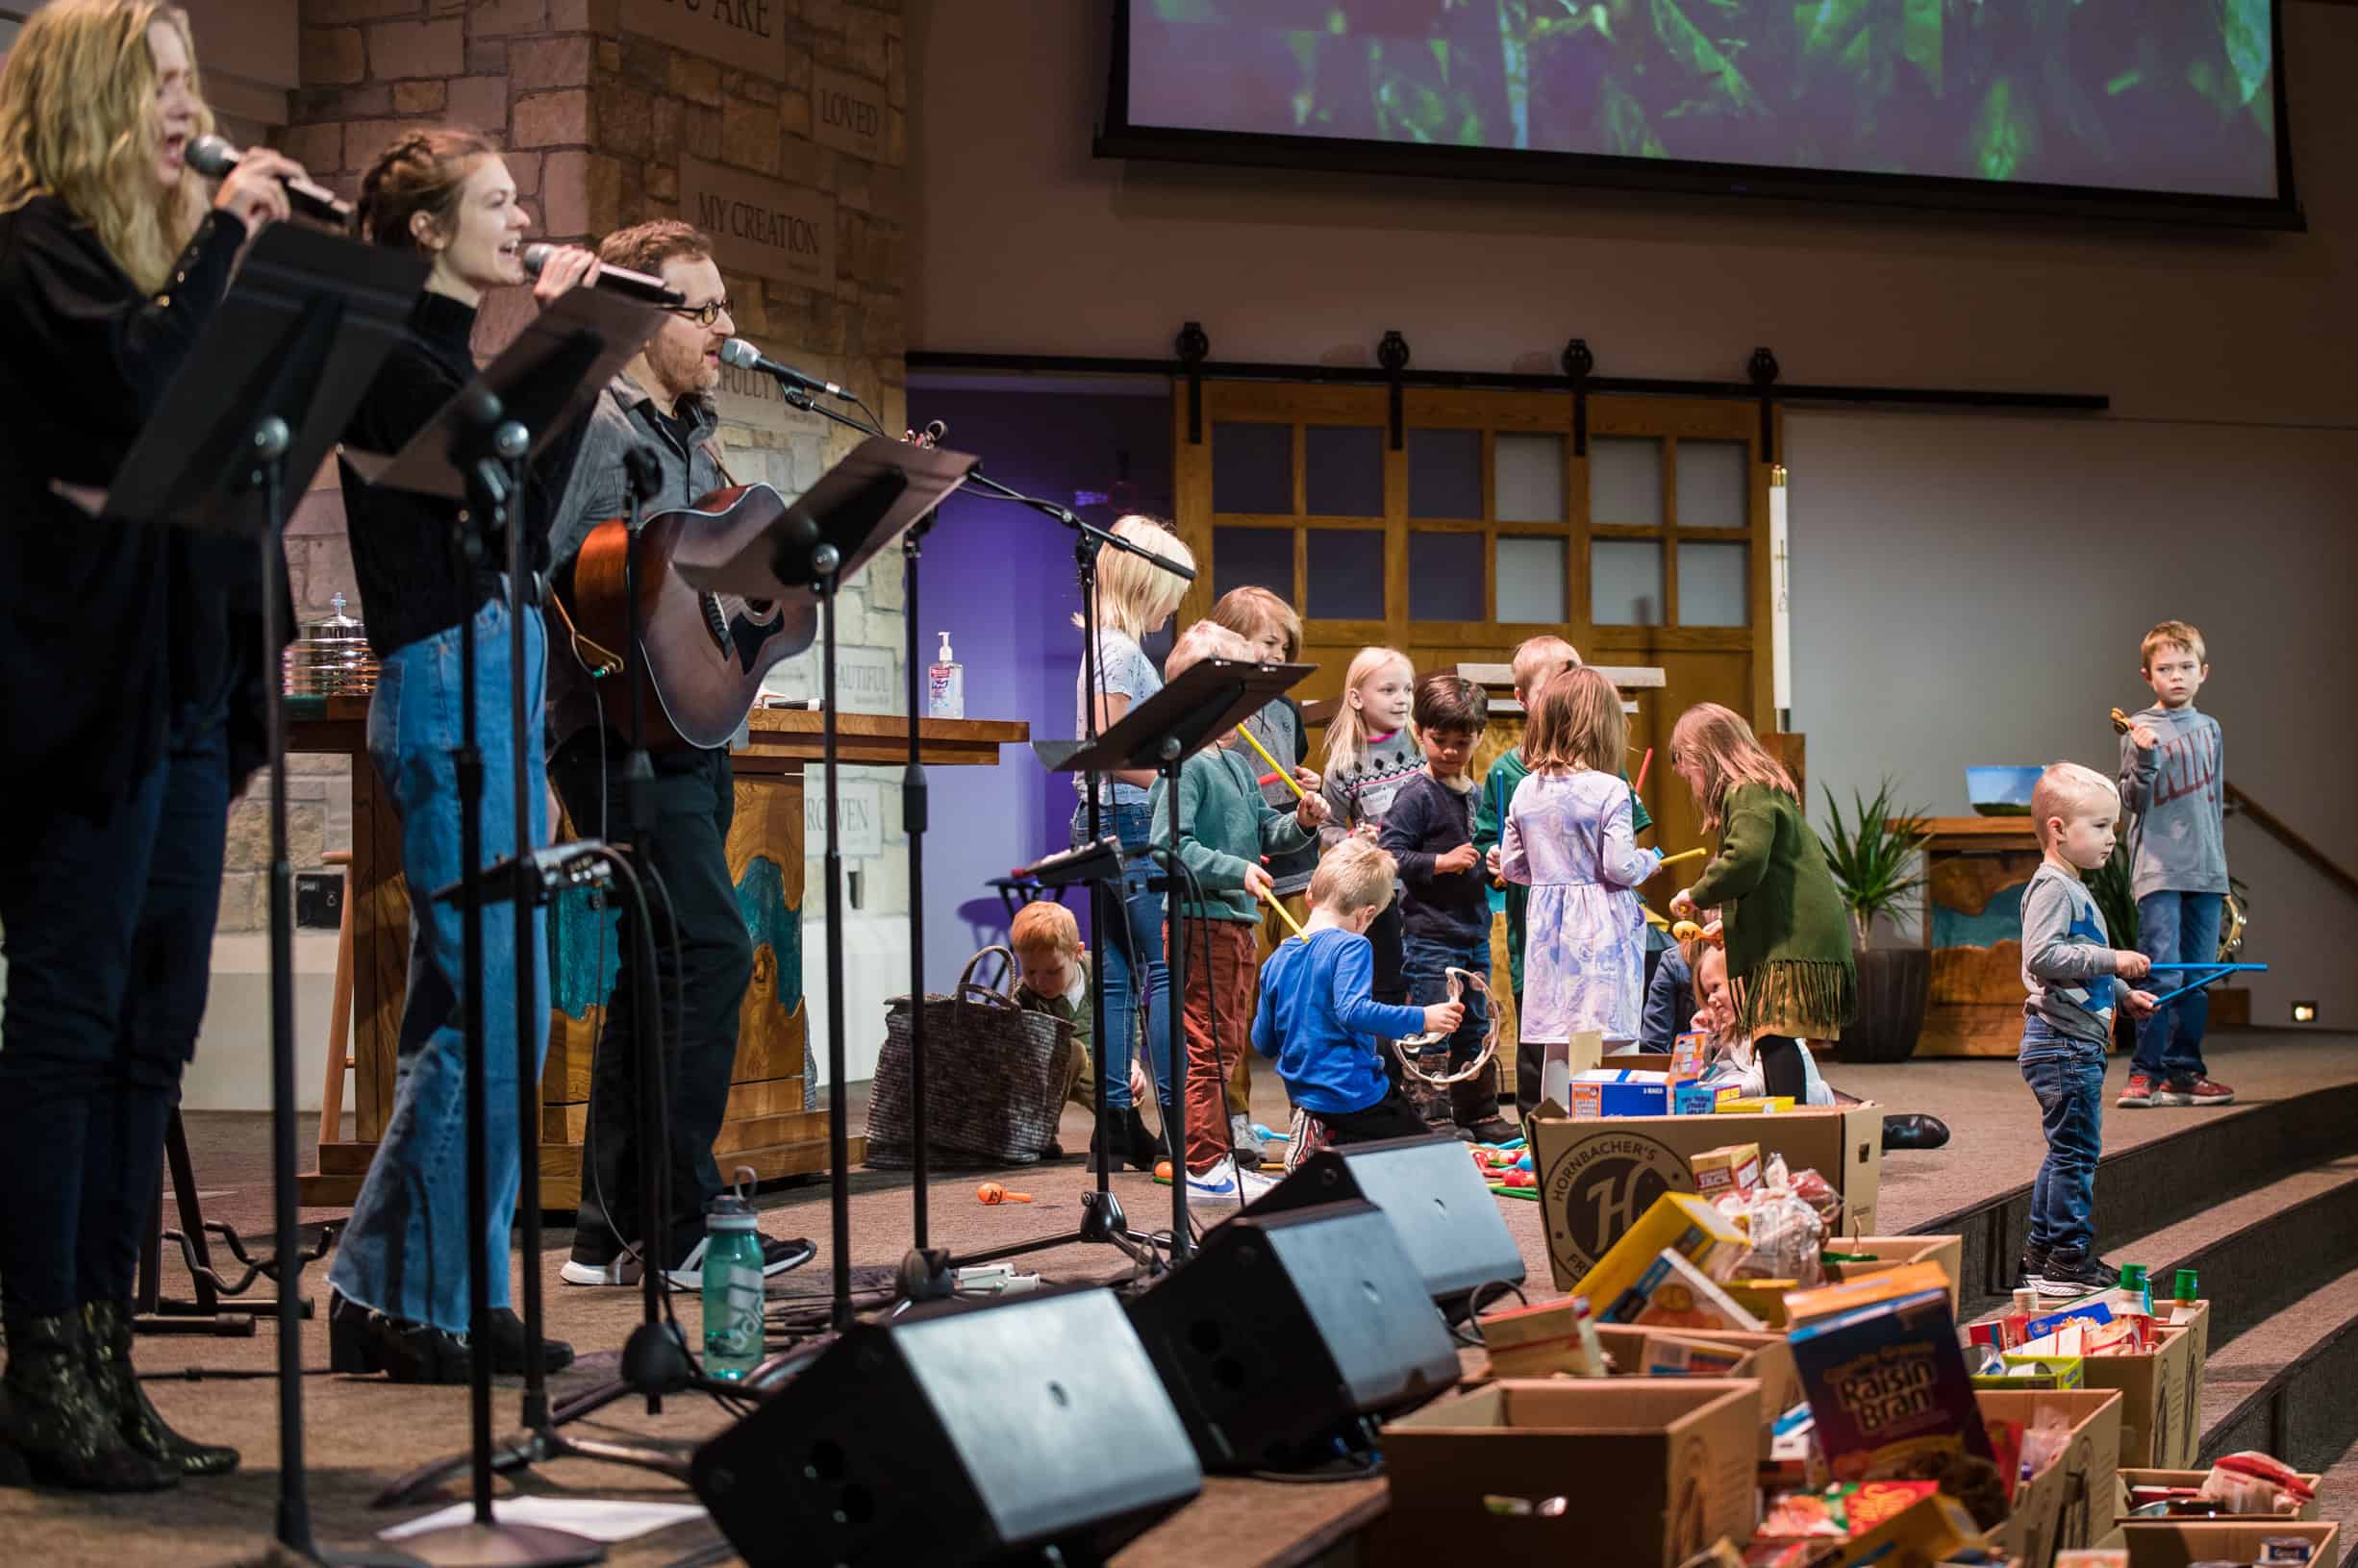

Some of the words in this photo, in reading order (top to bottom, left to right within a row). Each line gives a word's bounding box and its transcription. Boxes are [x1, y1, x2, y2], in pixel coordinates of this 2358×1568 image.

[820, 90, 877, 138] LOVED
[698, 192, 725, 234] MY
[730, 200, 818, 255] CREATION
[1552, 1140, 1658, 1203] HORNBACHER'S
[1840, 1360, 1933, 1407] Raisin
[1860, 1388, 1930, 1431] Bran
